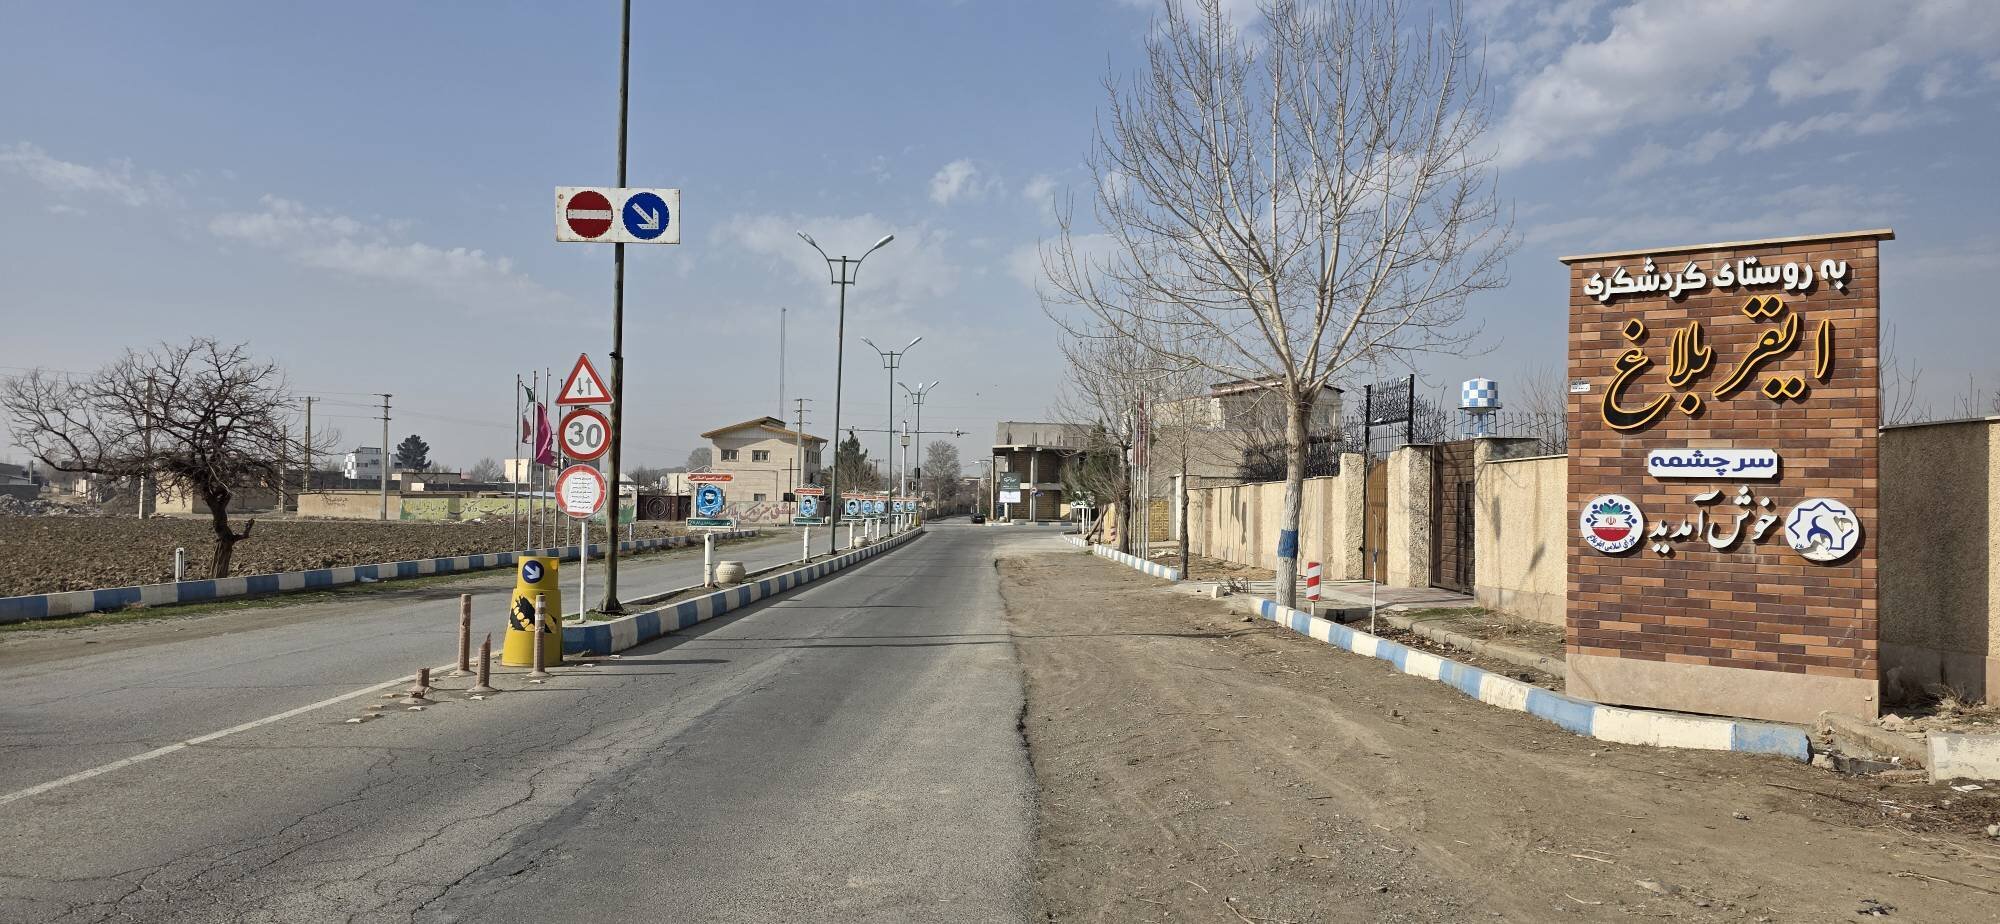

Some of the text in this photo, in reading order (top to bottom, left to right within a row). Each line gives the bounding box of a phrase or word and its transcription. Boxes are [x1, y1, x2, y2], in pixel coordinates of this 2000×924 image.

[1583, 256, 1847, 301] به روستای گردشگری
[1602, 295, 1830, 429] ایقر بلاغ
[568, 421, 602, 448] 30
[1648, 485, 1780, 555] خوش آمدید
[1604, 541, 1623, 551] اسلامی
